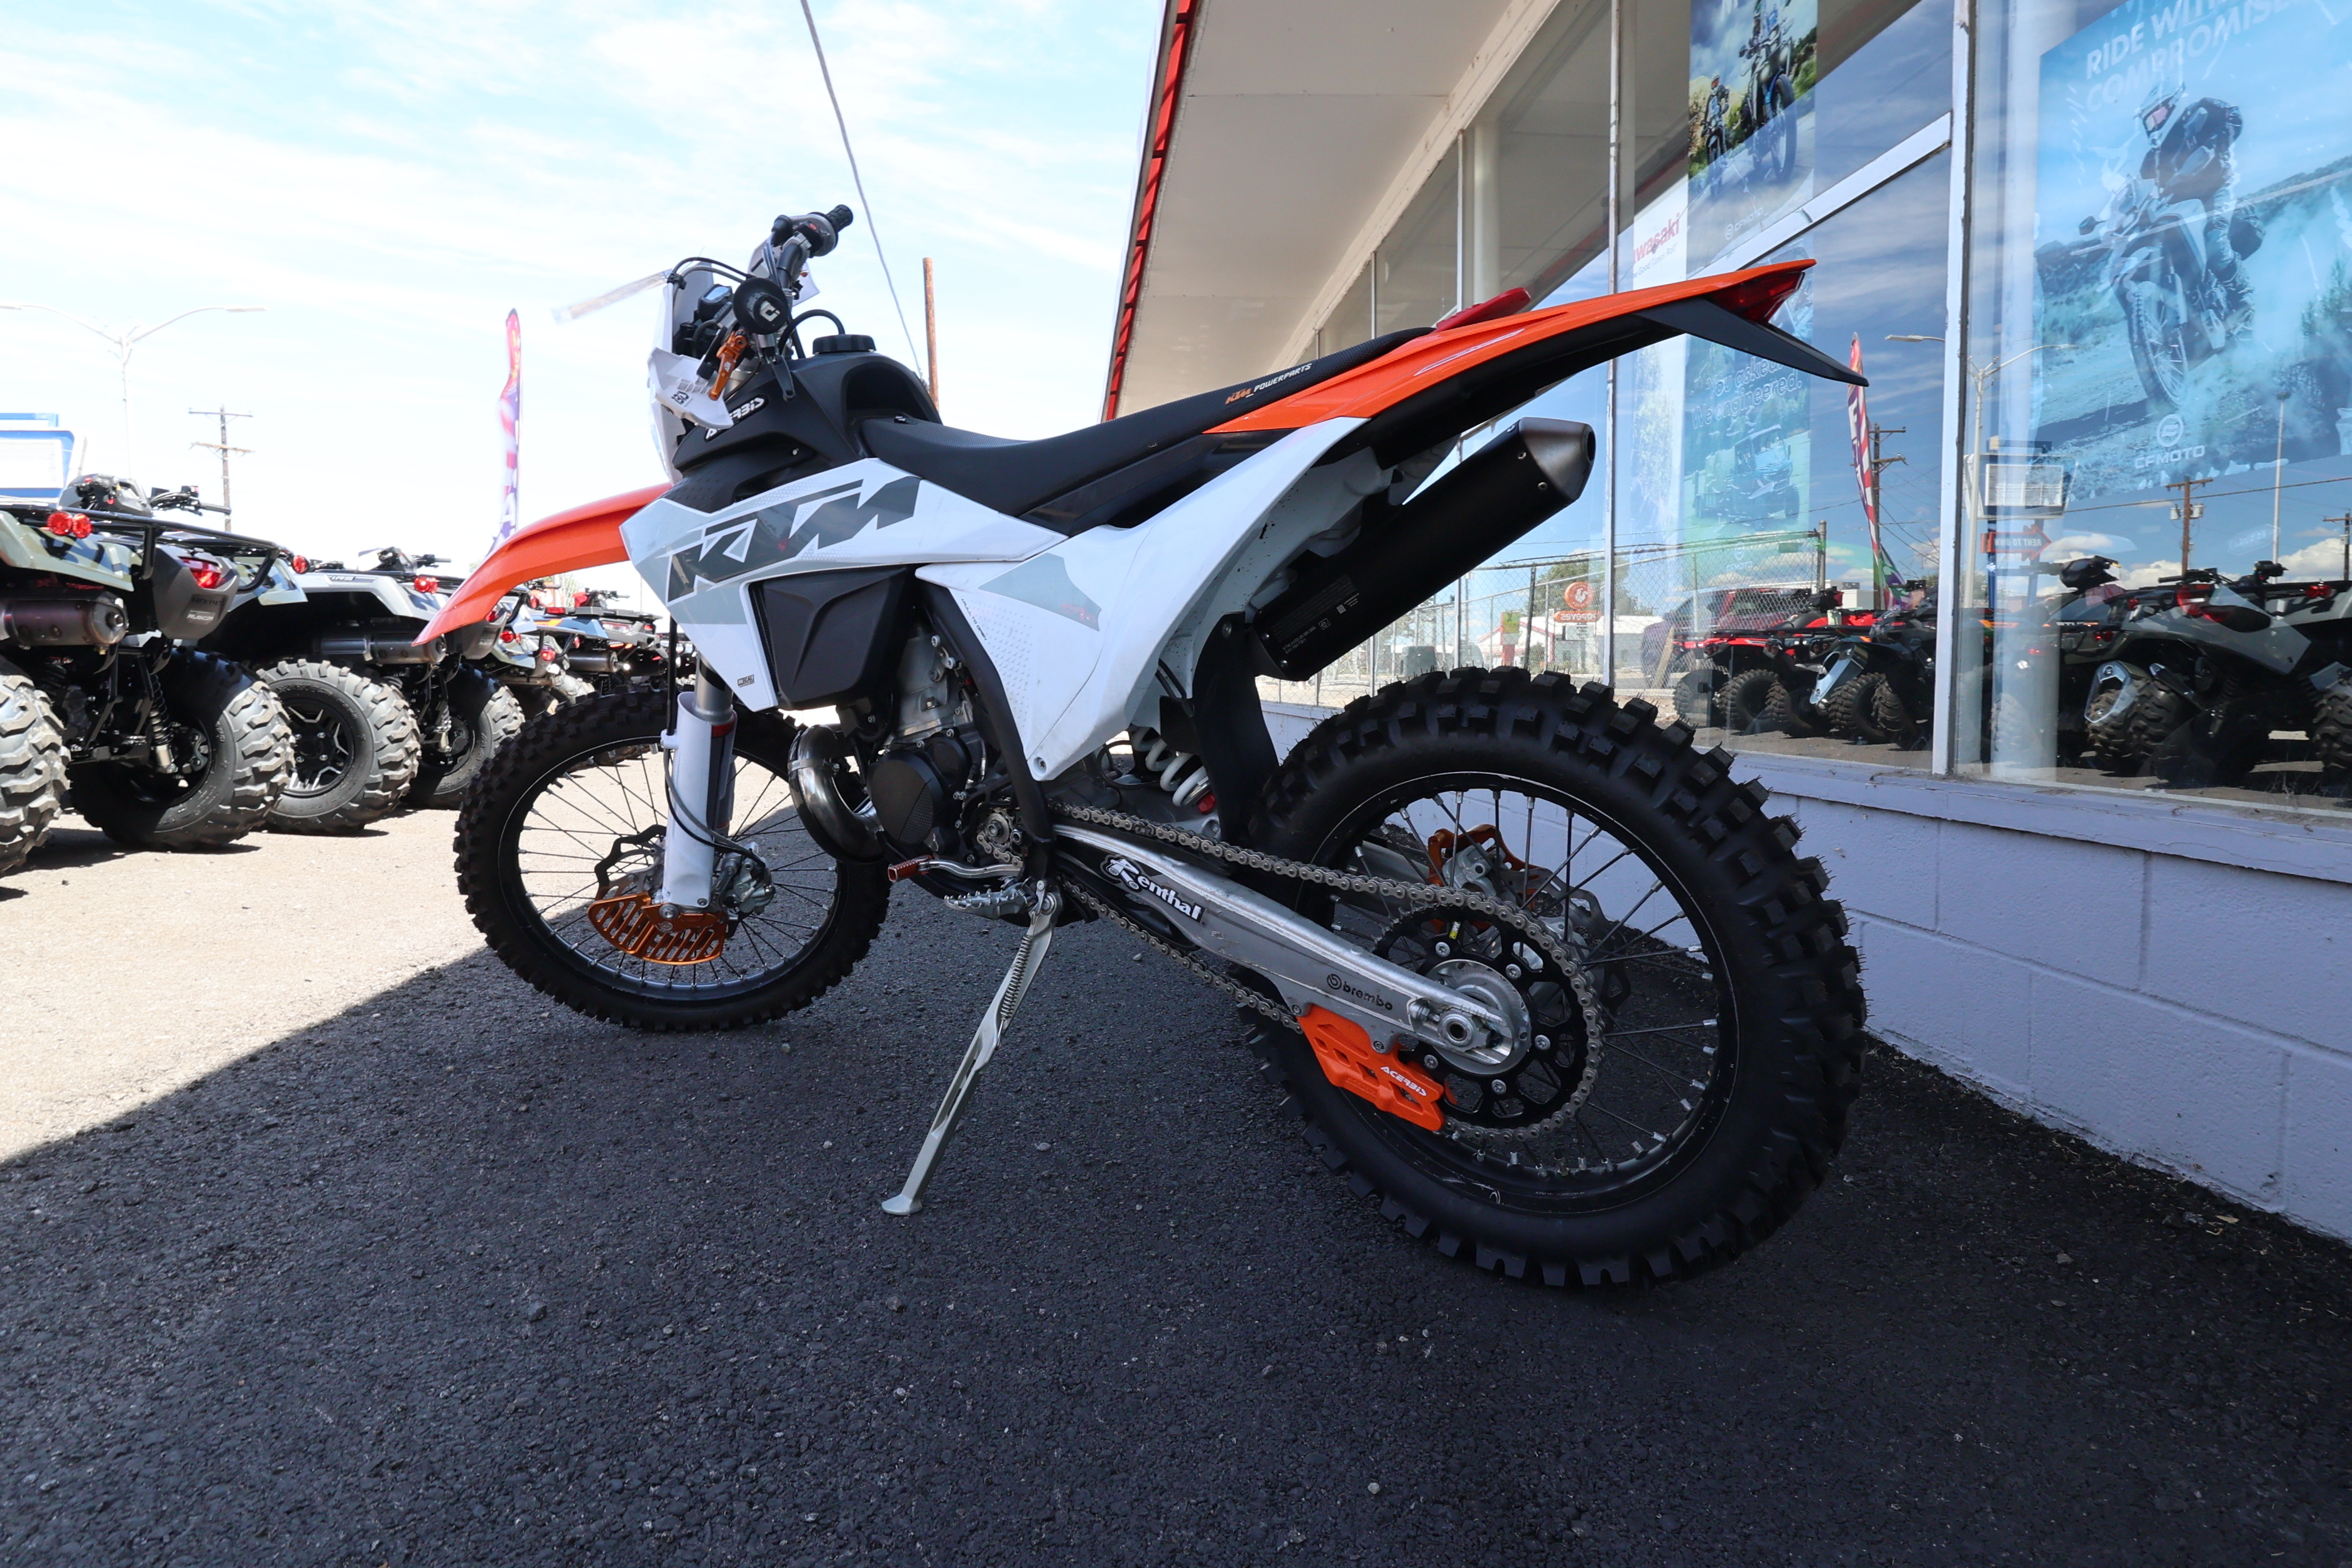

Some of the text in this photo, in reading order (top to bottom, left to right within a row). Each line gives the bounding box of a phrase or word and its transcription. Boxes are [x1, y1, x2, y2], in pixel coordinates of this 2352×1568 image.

[2086, 21, 2145, 80] RIDE
[1225, 363, 1312, 405] KTM POWERPARTS
[1707, 375, 1732, 399] You
[1691, 403, 1712, 430] We
[2135, 445, 2206, 469] CFMOTO
[667, 476, 921, 604] KTM
[1106, 858, 1202, 920] Renthal
[1342, 981, 1393, 1011] brembo
[1380, 1066, 1427, 1096] ACERBIS
